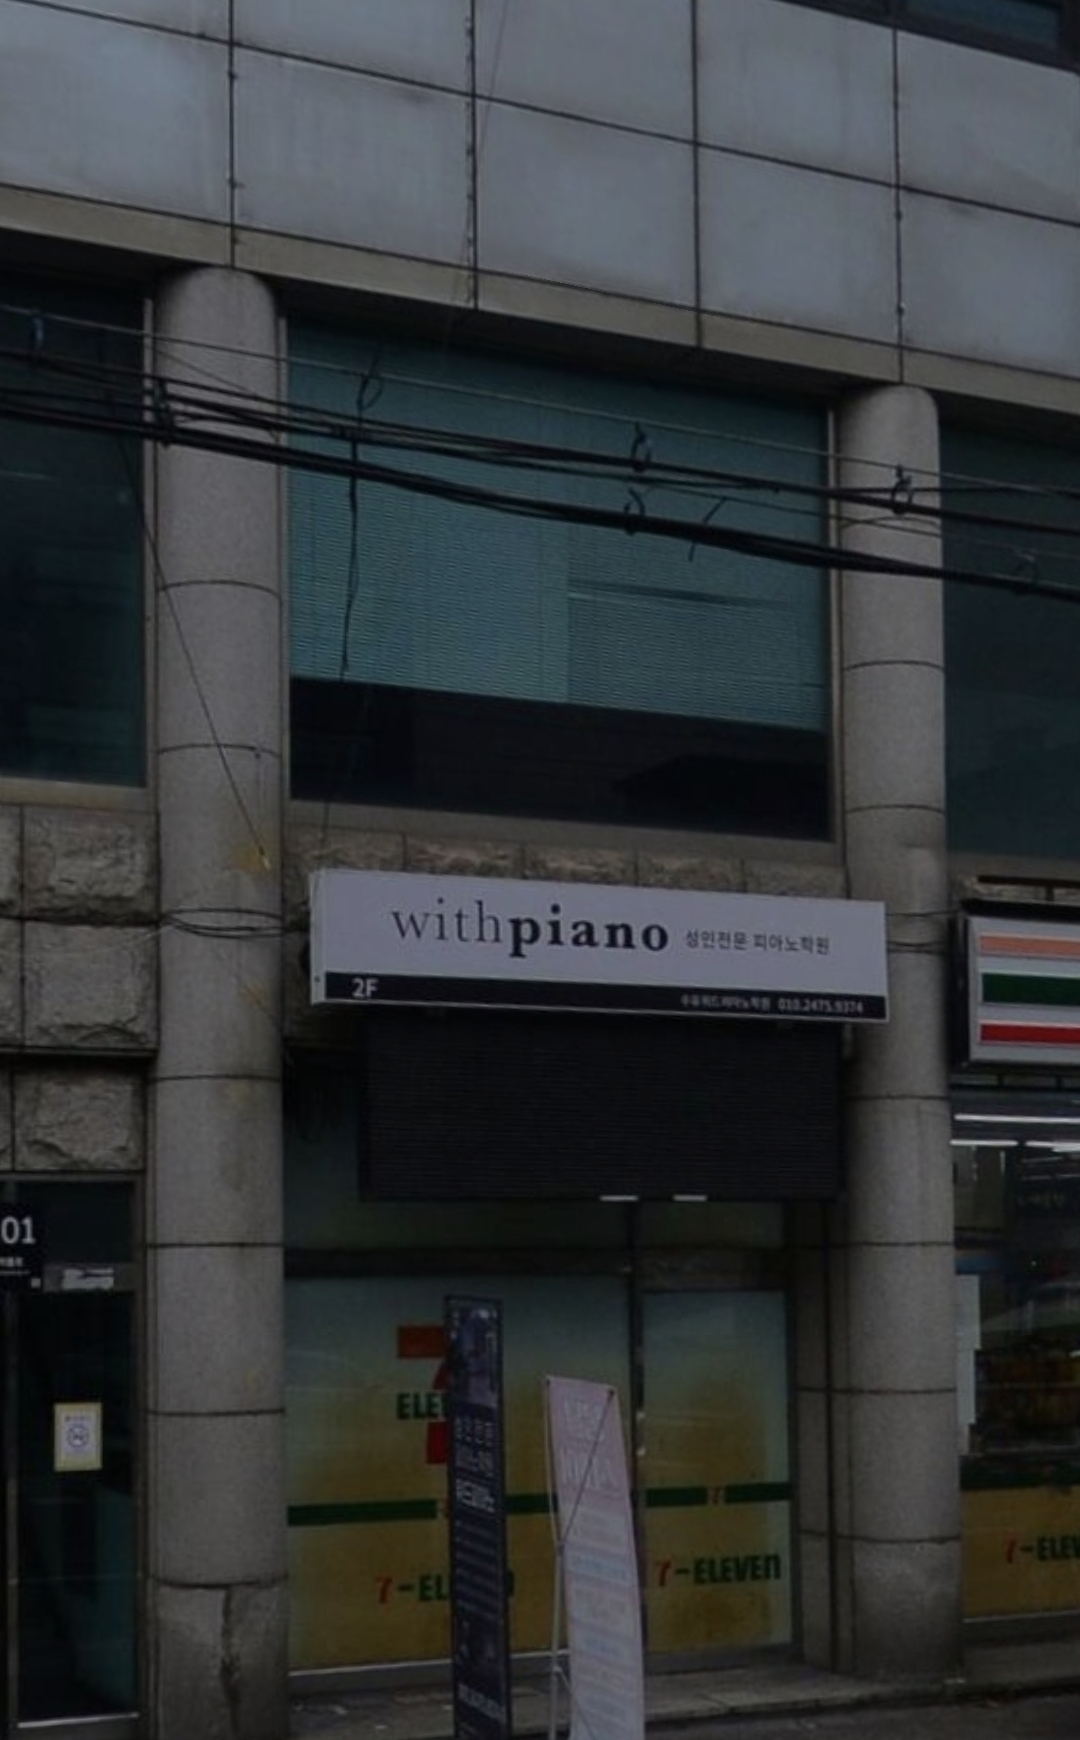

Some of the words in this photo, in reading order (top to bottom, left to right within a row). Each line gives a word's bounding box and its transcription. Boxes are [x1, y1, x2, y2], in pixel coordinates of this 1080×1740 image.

[392, 897, 669, 958] withpiano
[686, 929, 748, 951] 성인전문
[753, 933, 830, 955] 피아노학원
[352, 976, 380, 999] 2F
